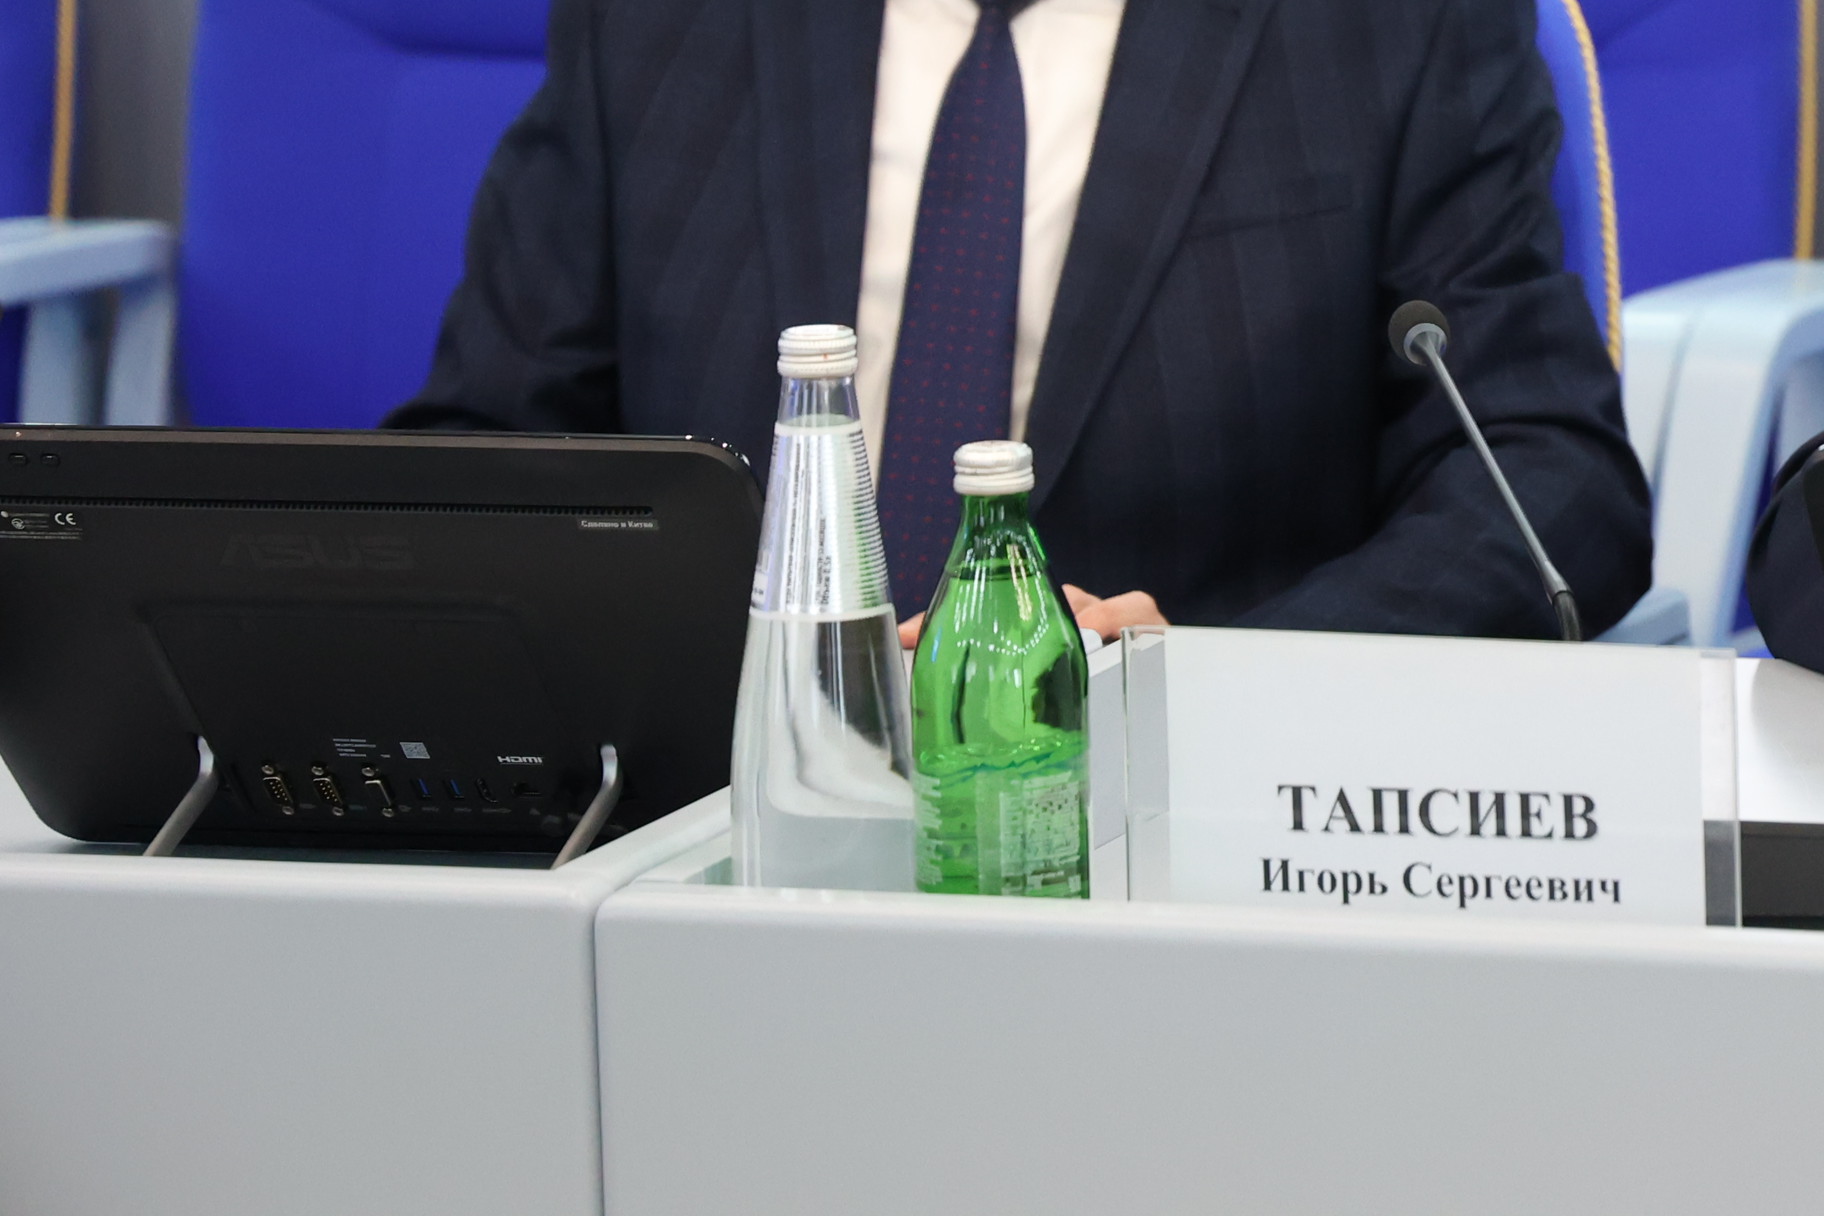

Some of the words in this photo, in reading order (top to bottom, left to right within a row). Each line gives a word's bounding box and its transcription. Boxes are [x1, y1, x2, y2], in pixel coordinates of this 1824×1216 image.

[220, 533, 415, 570] ASUS
[1277, 784, 1599, 841] ТАПСИЕВ
[1260, 856, 1389, 905] Игорь
[1401, 861, 1621, 909] Сергеевич
